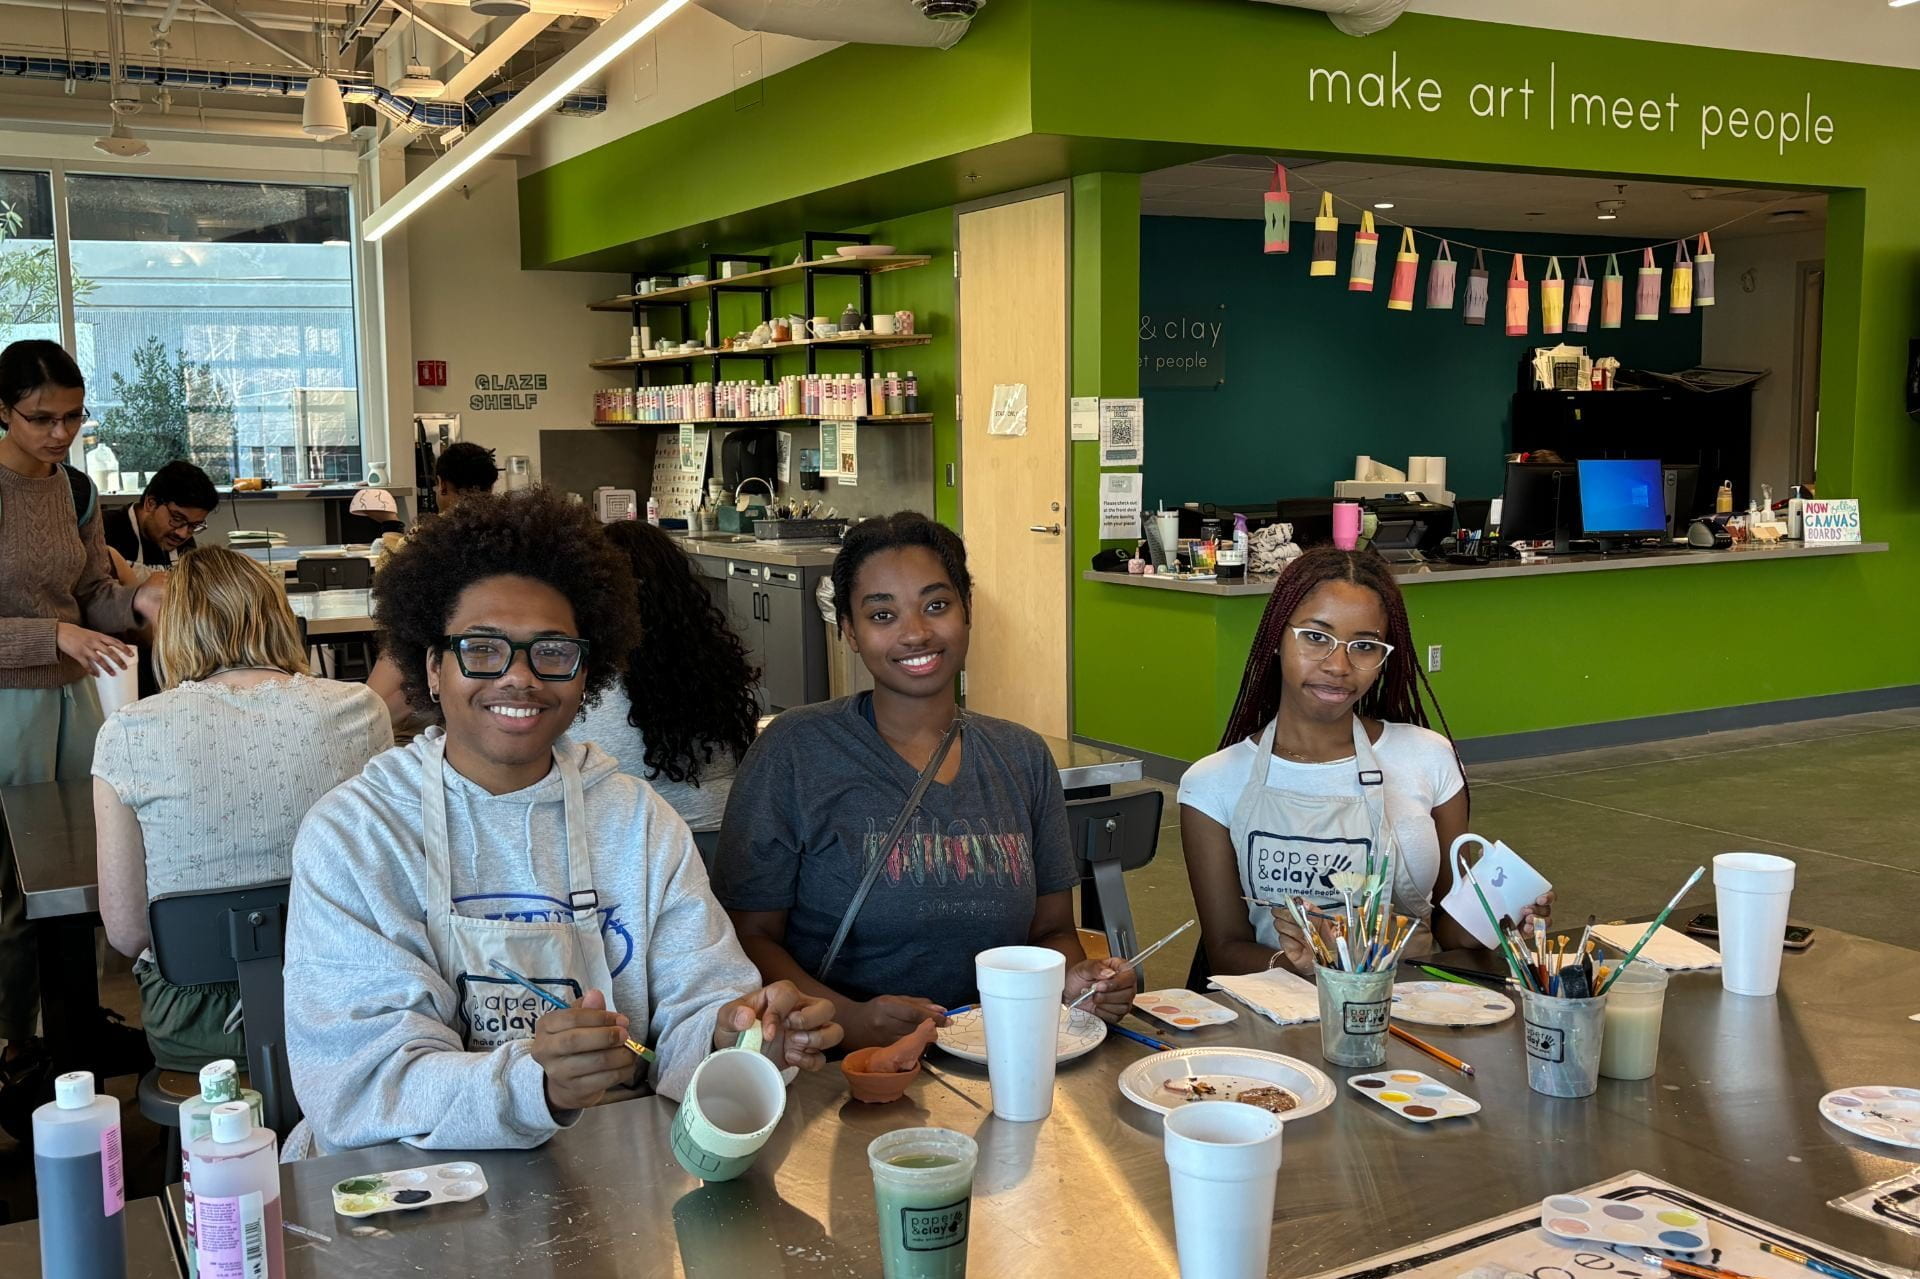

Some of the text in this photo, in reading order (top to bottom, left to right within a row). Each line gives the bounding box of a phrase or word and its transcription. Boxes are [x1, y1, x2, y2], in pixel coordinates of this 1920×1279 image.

[1309, 51, 1442, 112] make
[1469, 78, 1535, 119] art
[1570, 92, 1680, 132] meet
[1701, 92, 1835, 155] people
[1156, 351, 1207, 373] people
[475, 374, 548, 391] GLAZE
[469, 393, 538, 411] SHELF
[1806, 502, 1829, 514] NOW
[1805, 512, 1858, 528] CANVAS
[1808, 528, 1842, 540] BOARDS
[1259, 848, 1332, 870] paper
[473, 994, 552, 1017] aper
[911, 1212, 953, 1229] paper
